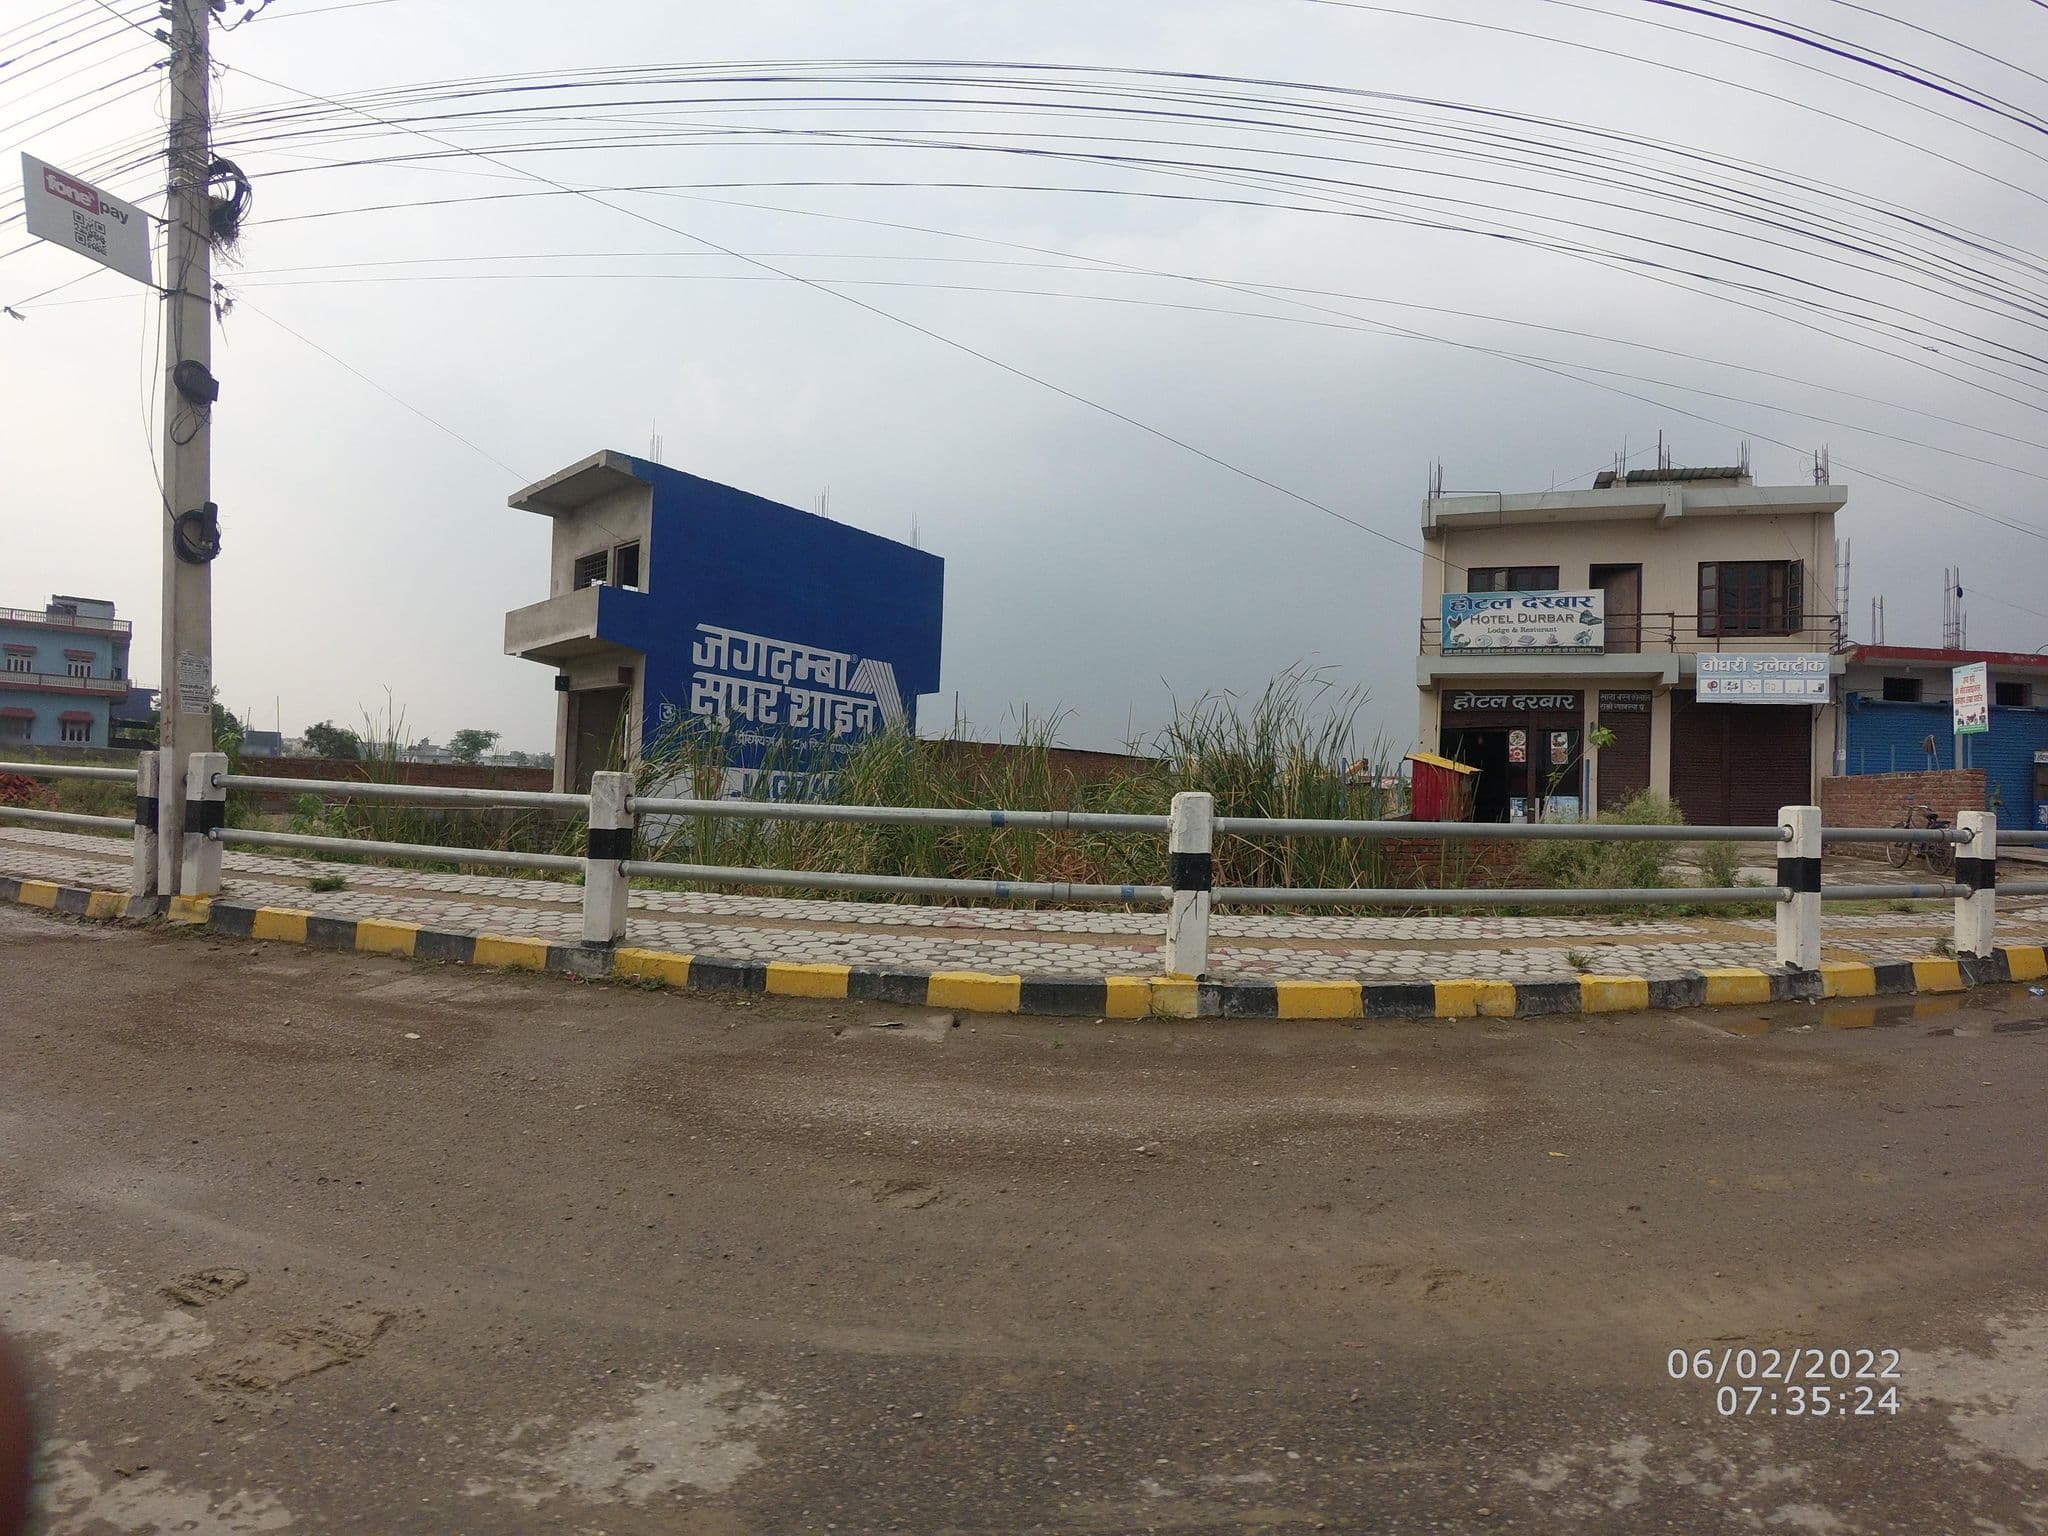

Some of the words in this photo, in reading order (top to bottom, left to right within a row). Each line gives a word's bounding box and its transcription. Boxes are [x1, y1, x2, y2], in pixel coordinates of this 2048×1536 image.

[1450, 595, 1513, 612] होटल
[1522, 595, 1595, 610] दरबार
[1470, 614, 1513, 625] HOTEL
[1517, 613, 1575, 624] DURBAR
[692, 623, 852, 690] जगदम्बा
[690, 672, 783, 733] सुपर
[784, 686, 877, 735] शाइन
[1453, 691, 1511, 710] होटल
[1512, 694, 1575, 710] दरबार
